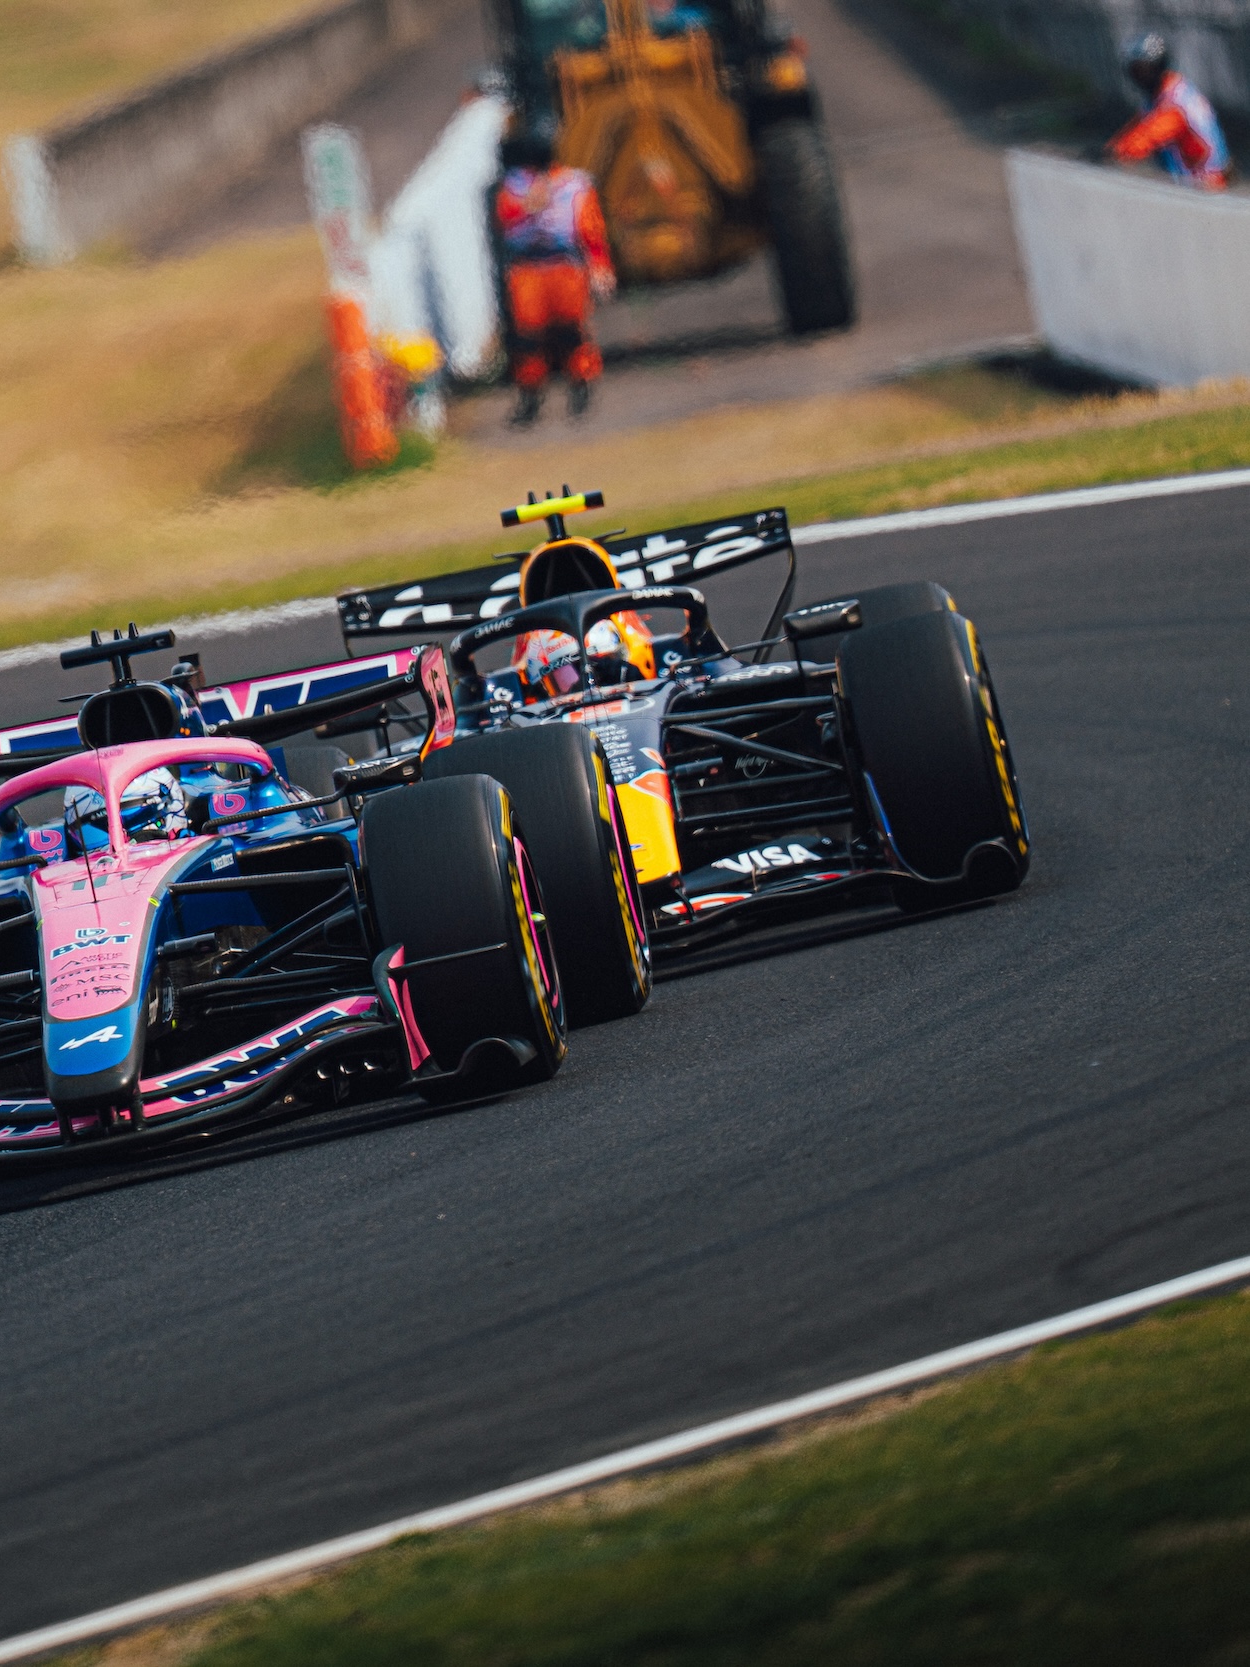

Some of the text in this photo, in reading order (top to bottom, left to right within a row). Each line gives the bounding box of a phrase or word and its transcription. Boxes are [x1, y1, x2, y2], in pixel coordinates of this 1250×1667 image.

[724, 843, 822, 874] VISA
[51, 934, 133, 960] BWT
[76, 974, 130, 986] MSC
[51, 989, 88, 1008] eni
